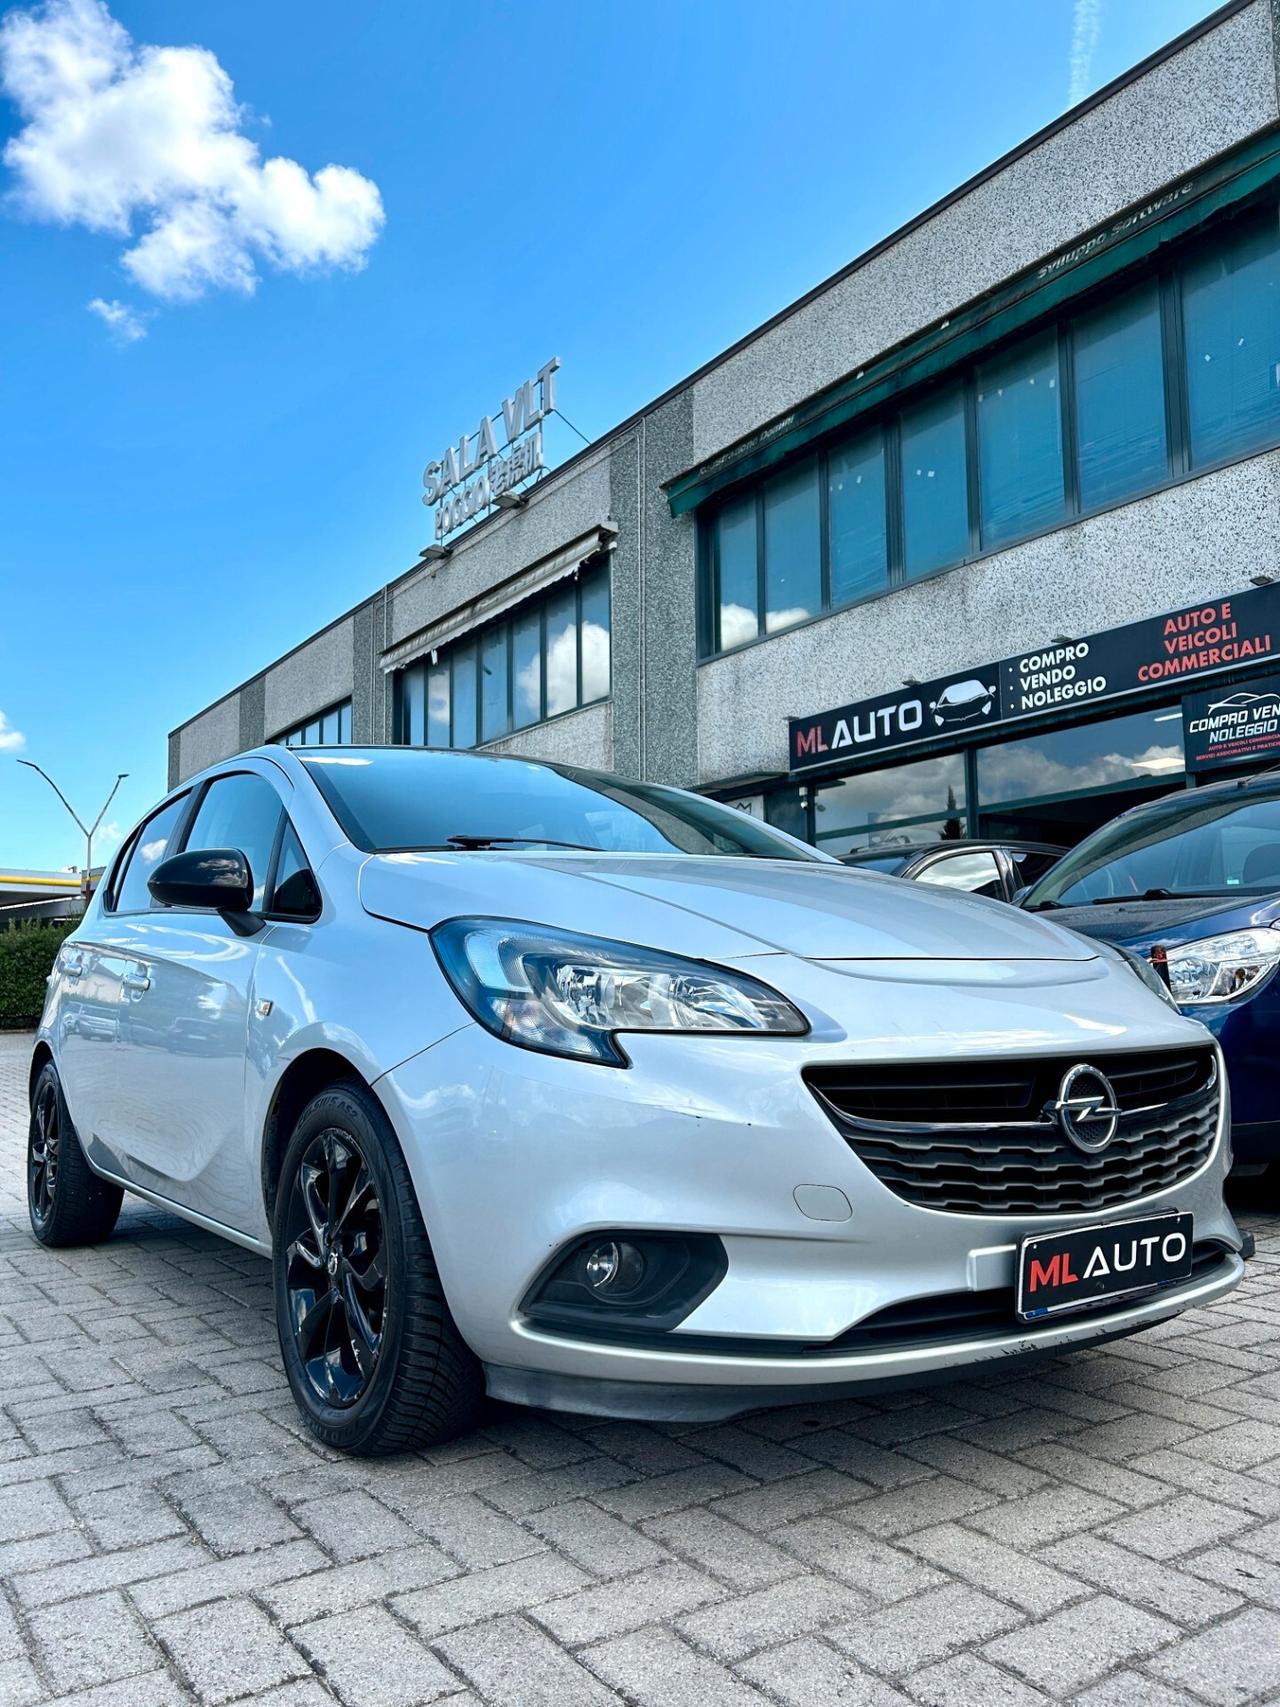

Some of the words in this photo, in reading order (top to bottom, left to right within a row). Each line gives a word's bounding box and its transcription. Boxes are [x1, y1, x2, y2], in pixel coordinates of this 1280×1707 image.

[422, 415, 498, 507] SALA
[501, 356, 561, 443] VLT
[1164, 604, 1217, 636] AUTO
[1221, 602, 1232, 621] E
[1164, 622, 1237, 655] VEICOLI
[1019, 642, 1090, 673] COMPRO
[1137, 634, 1272, 683] COMMERCIALI
[1019, 665, 1076, 692] VENDO
[1020, 676, 1107, 711] NOLEGGIO
[796, 725, 829, 758] ML
[831, 699, 923, 749] AUTO
[1189, 710, 1249, 734] COMPRO
[1209, 718, 1278, 744] NOLEGGIO
[1028, 1252, 1079, 1293] ML
[1083, 1232, 1187, 1279] AUTO
